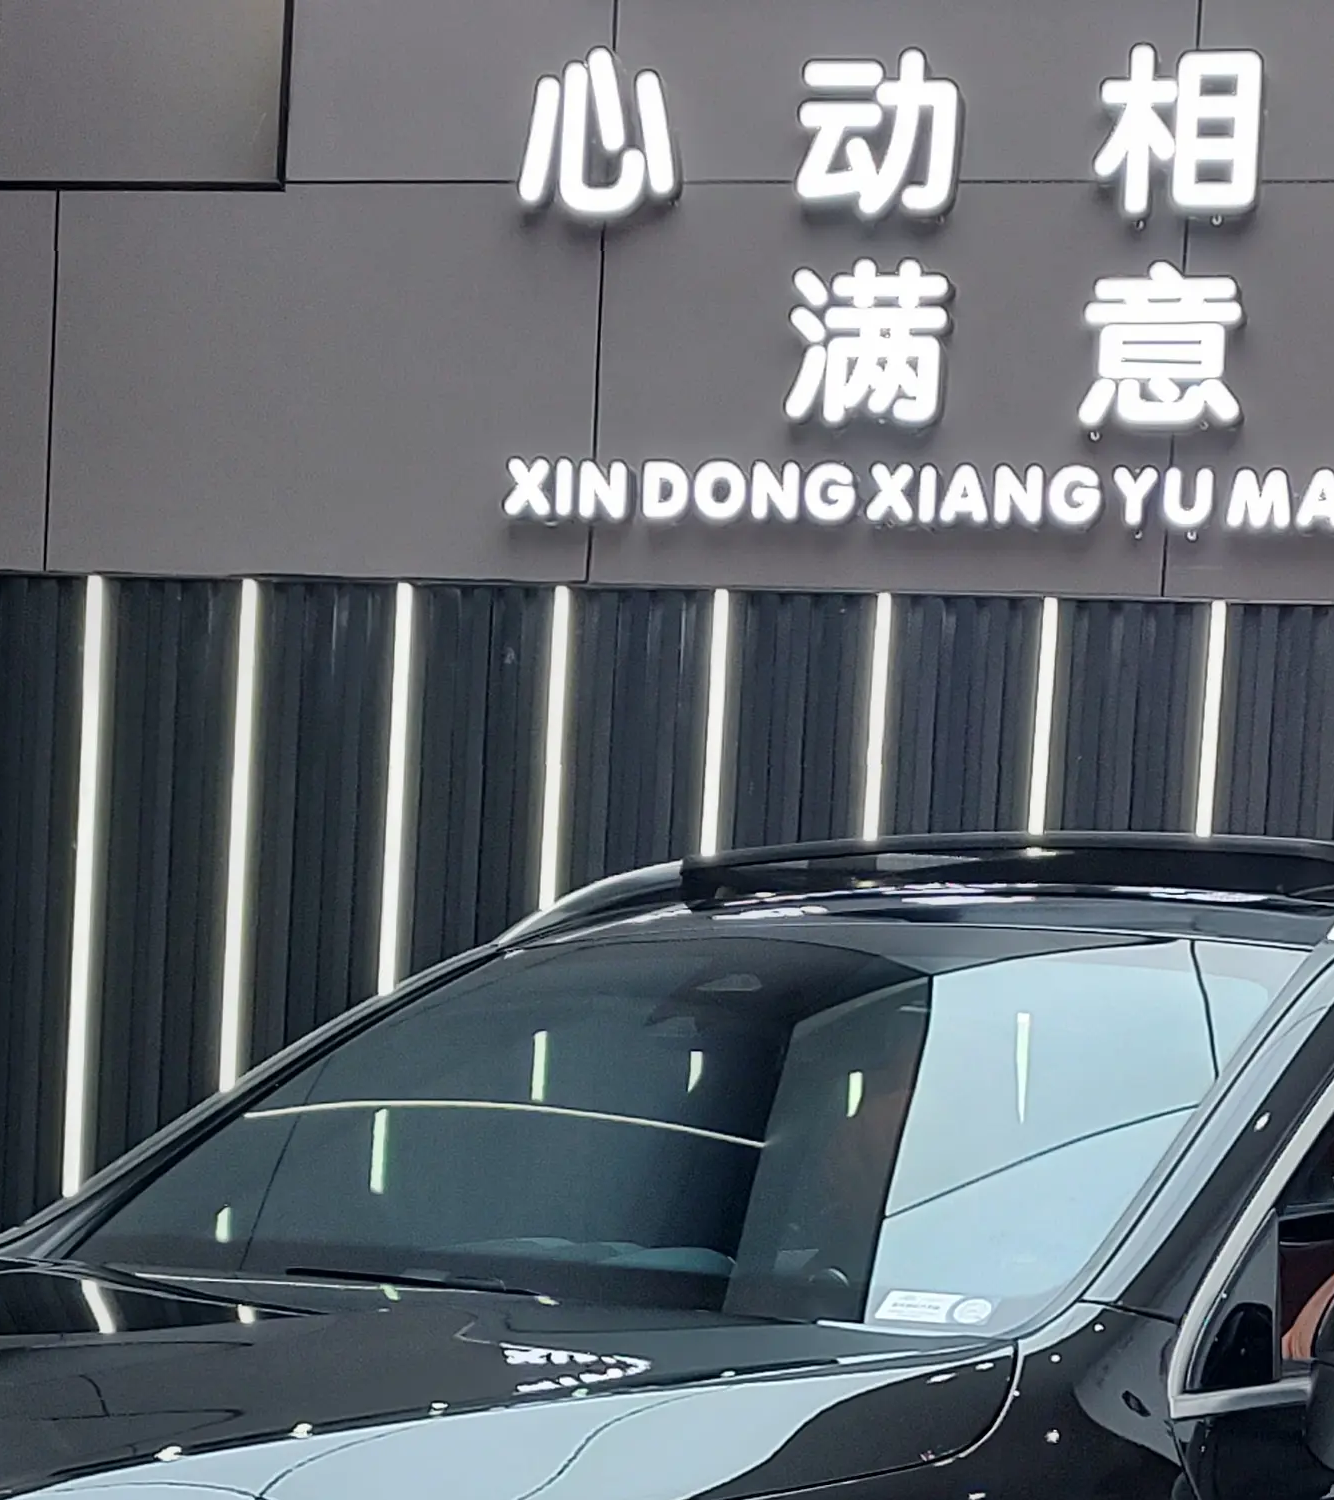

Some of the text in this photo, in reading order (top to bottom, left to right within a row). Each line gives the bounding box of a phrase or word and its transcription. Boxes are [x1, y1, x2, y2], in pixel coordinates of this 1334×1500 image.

[502, 456, 629, 520] XIN
[641, 459, 858, 523] DONG
[864, 462, 1104, 526] XIANG
[1111, 464, 1216, 528] YU
